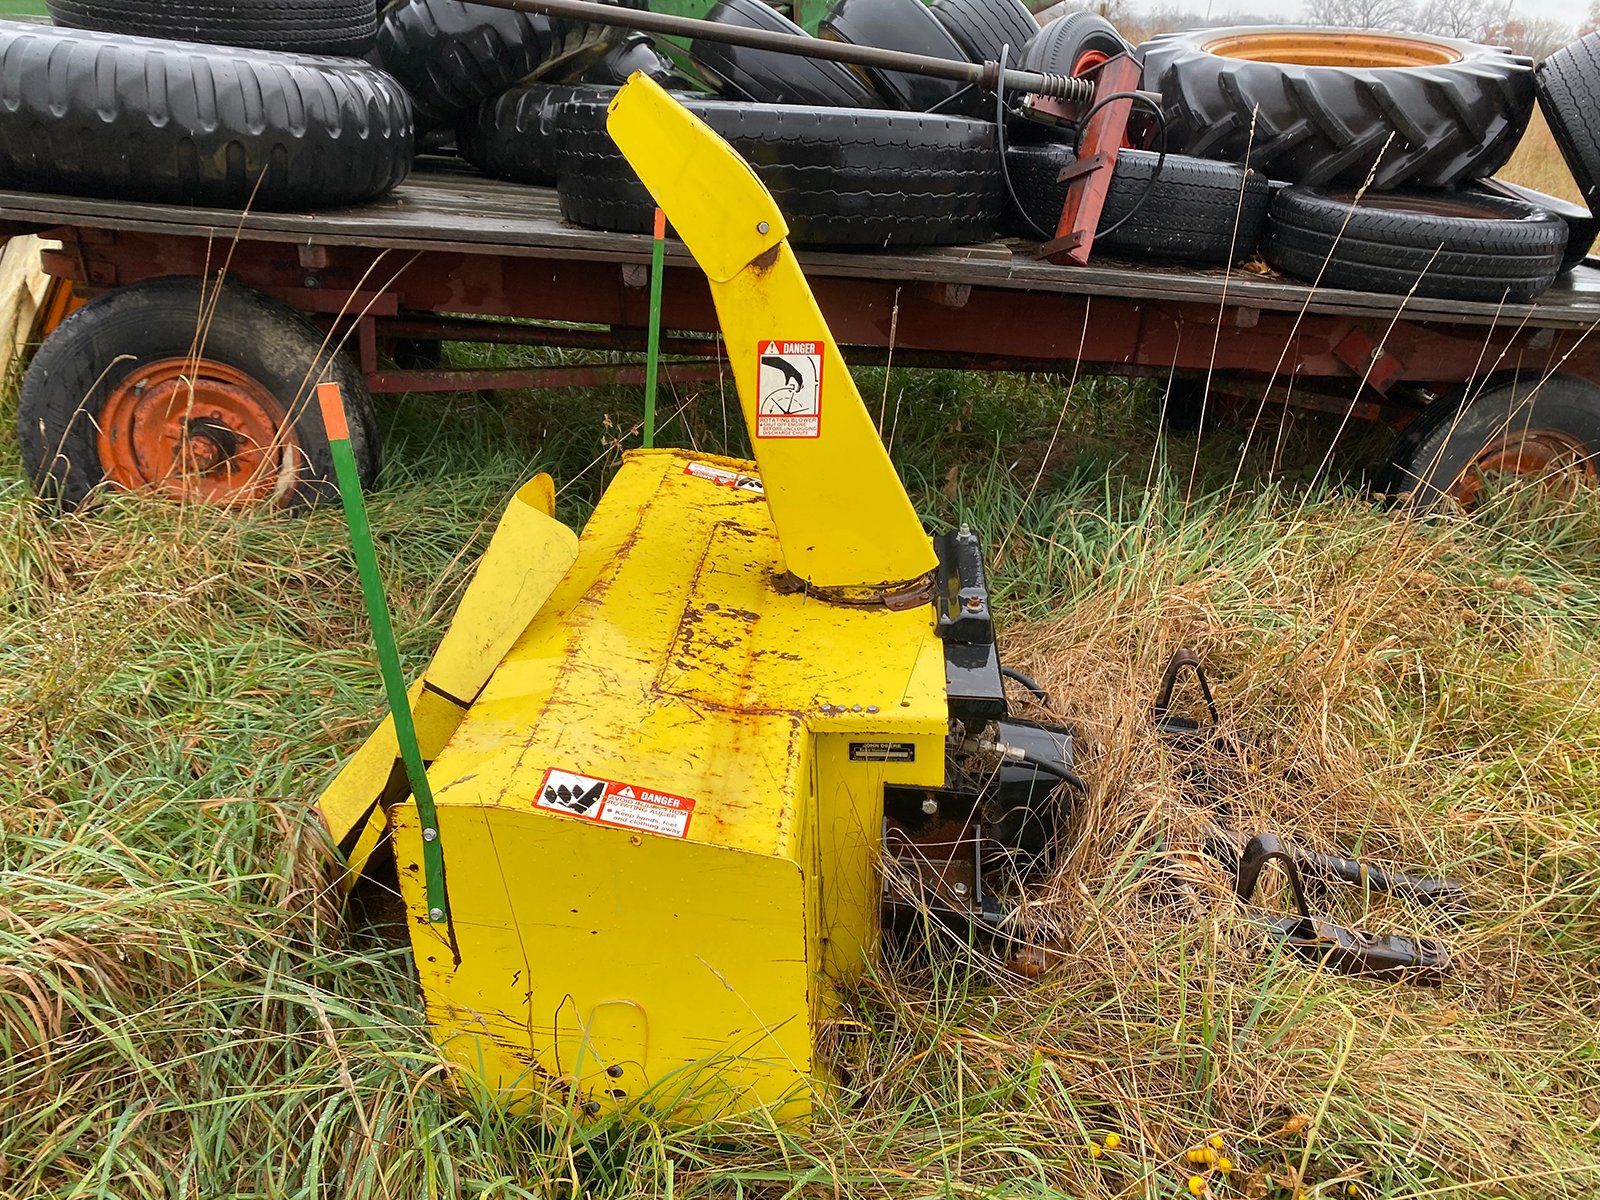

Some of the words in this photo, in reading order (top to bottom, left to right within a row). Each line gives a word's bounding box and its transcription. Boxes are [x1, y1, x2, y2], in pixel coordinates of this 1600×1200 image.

[783, 343, 815, 354] DANGER
[609, 795, 633, 804] AVOID
[640, 792, 680, 807] DANGER
[607, 800, 648, 813] ROTATING
[650, 810, 677, 819] AUGER
[614, 810, 634, 819] Keep
[612, 815, 627, 823] and
[629, 818, 659, 830] clothing
